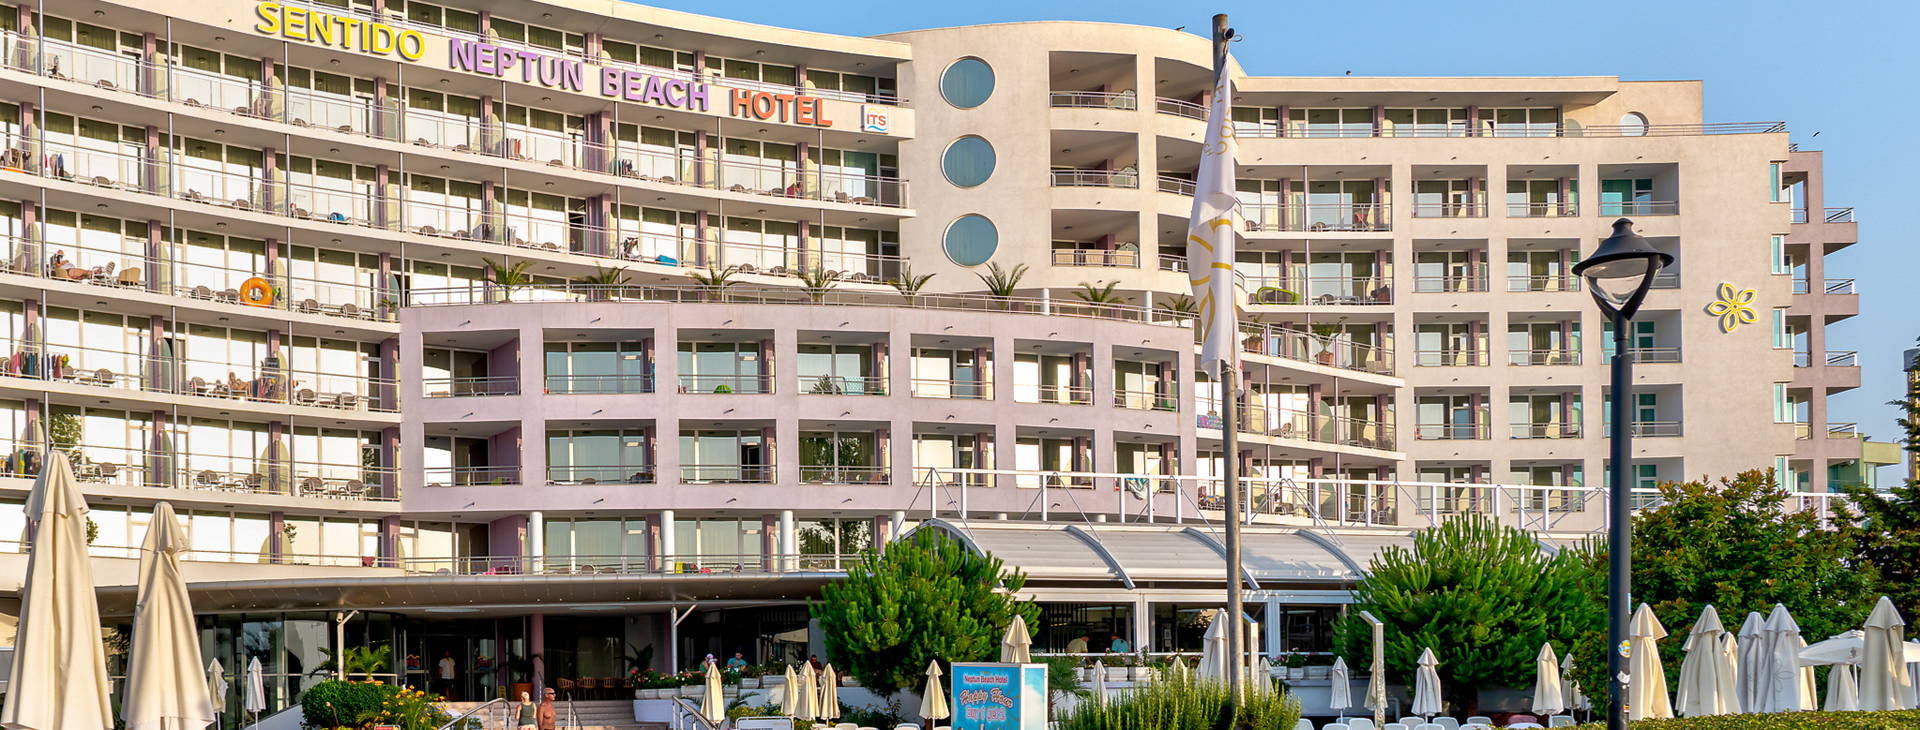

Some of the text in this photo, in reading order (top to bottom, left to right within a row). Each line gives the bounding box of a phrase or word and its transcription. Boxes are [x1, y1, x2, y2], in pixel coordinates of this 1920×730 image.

[256, 1, 833, 127] SENTIDO NEPTUN BEACH HOTEL
[866, 113, 887, 126] ITS
[980, 675, 994, 684] Beach
[995, 675, 1008, 684] Hotel
[960, 687, 1014, 708] Happy Hour
